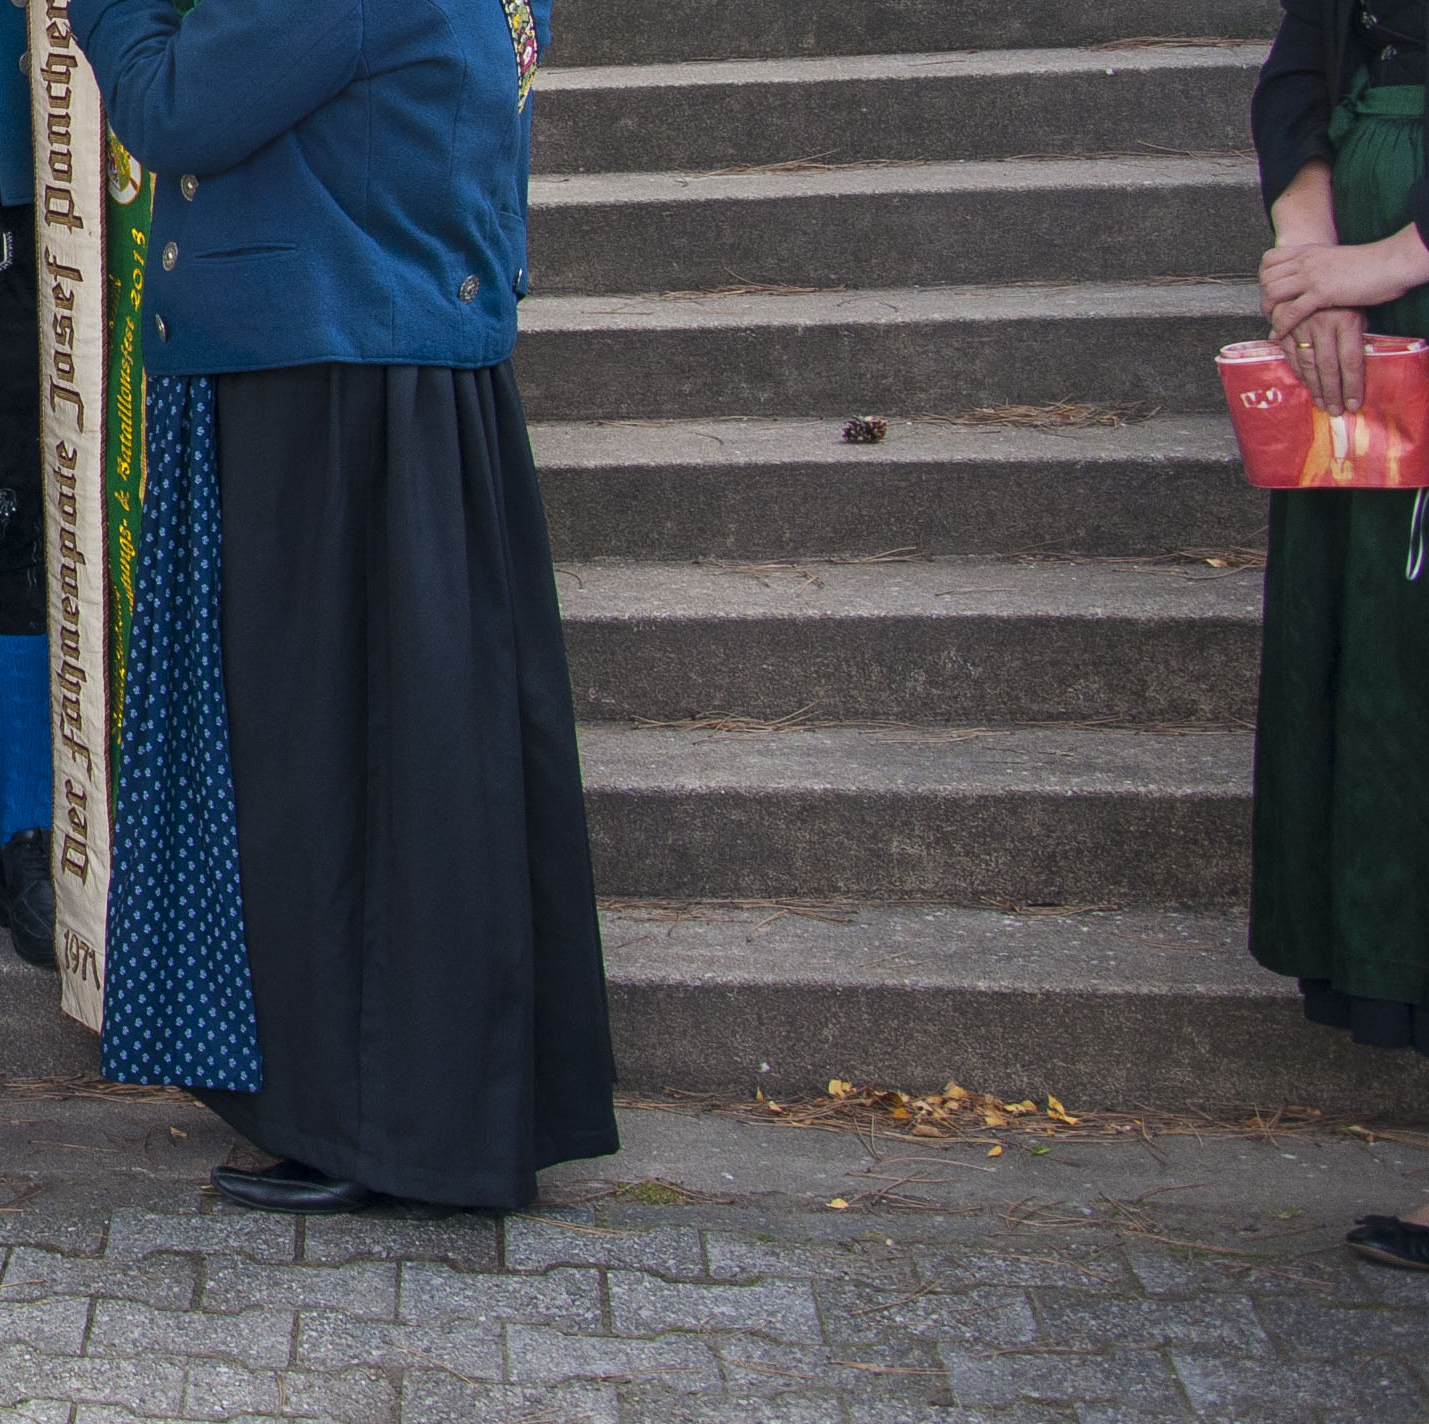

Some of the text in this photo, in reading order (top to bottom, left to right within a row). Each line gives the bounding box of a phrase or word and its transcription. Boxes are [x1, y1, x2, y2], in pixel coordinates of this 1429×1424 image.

[44, 245, 85, 435] Josef
[116, 316, 135, 482] Bataillonsfest
[53, 439, 93, 782] Fahnenpate
[59, 778, 90, 888] Der
[63, 928, 101, 991] 1971
